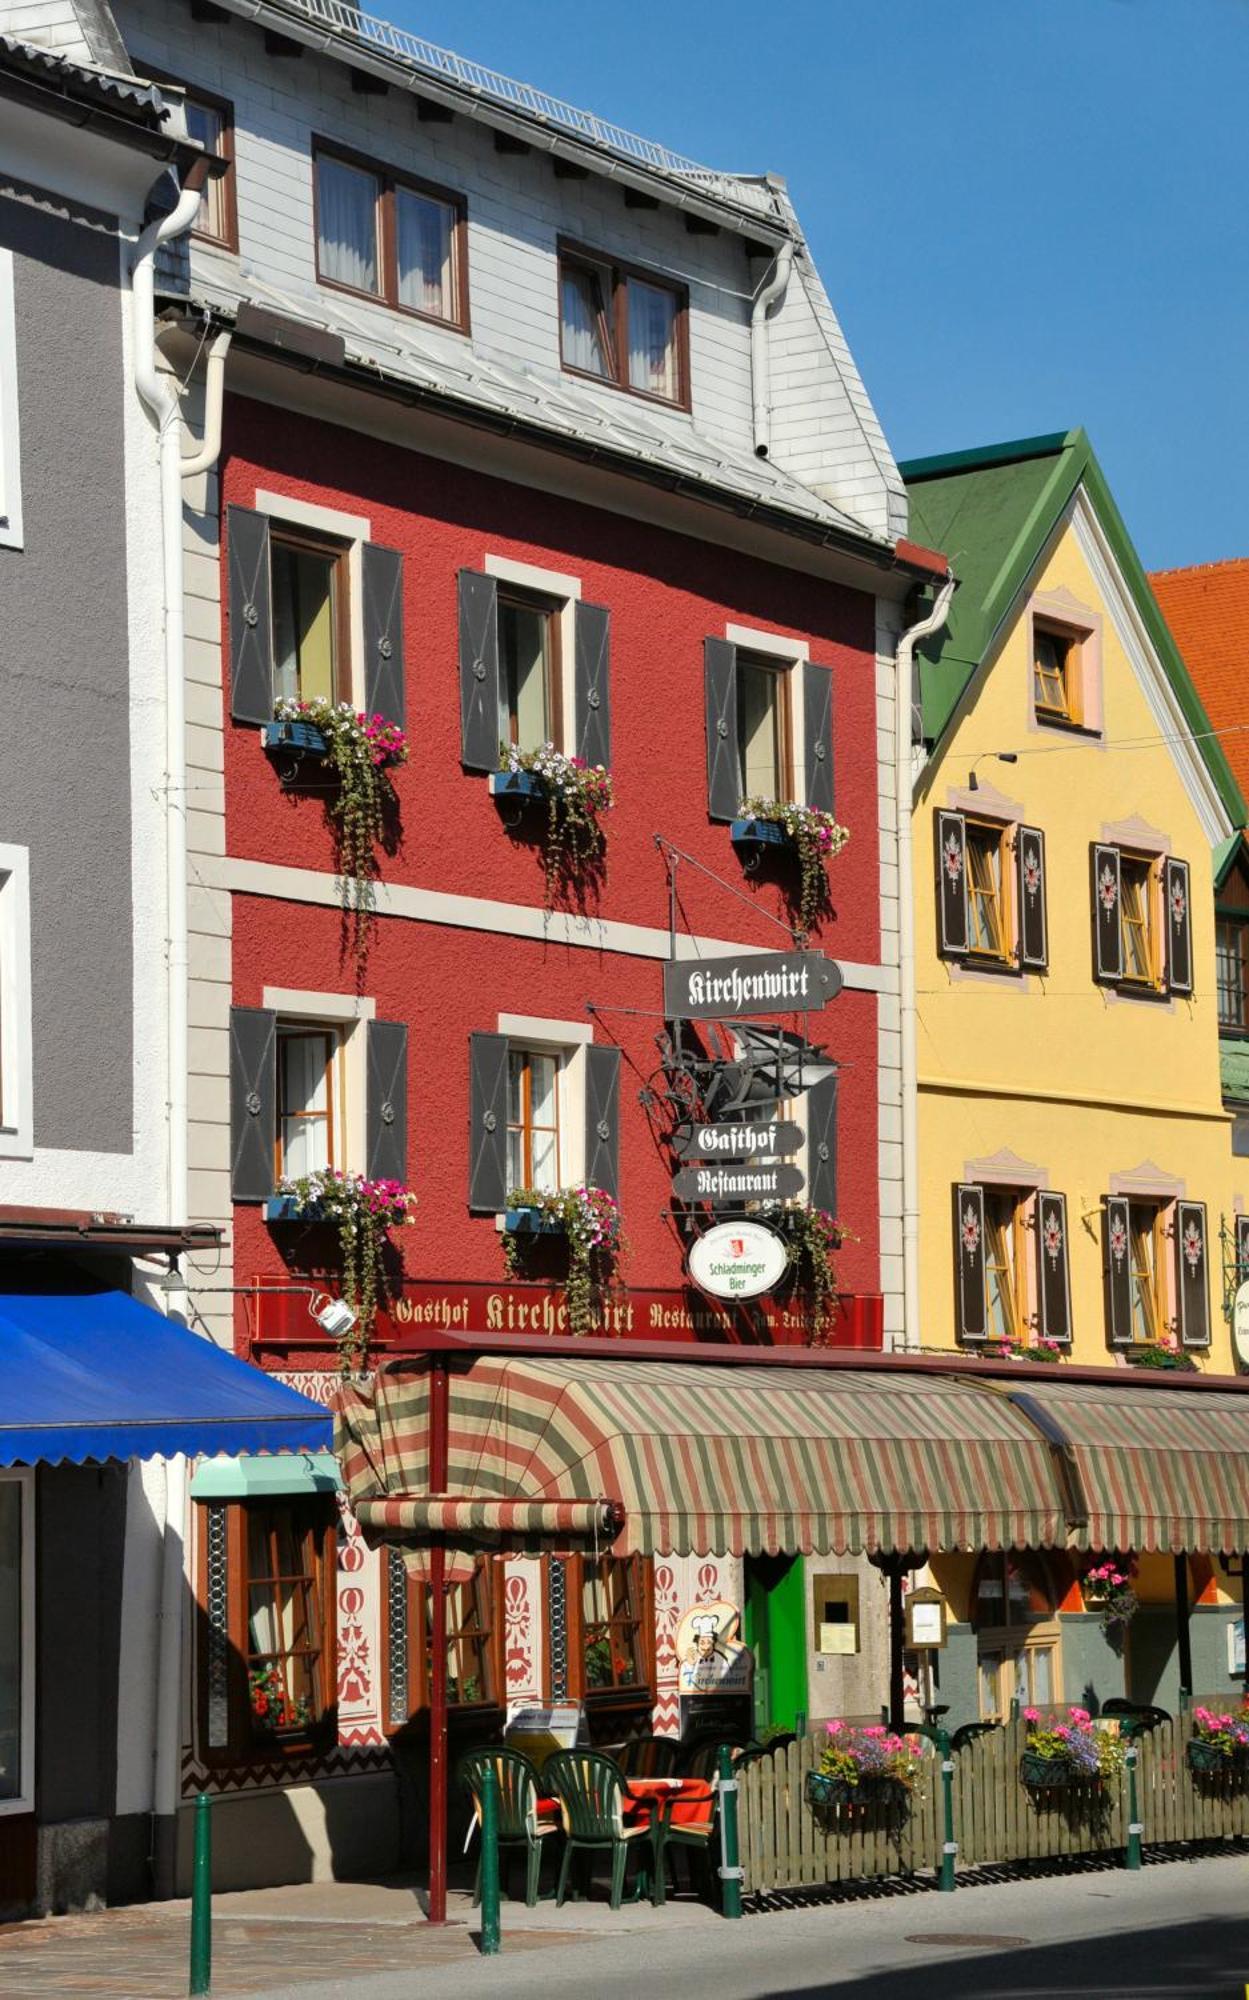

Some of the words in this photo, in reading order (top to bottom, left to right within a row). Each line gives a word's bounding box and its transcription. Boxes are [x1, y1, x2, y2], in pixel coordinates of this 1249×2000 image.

[688, 964, 809, 1012] Kirchenwirt
[698, 1125, 777, 1156] Gasthof
[696, 1169, 778, 1198] Restaurant
[709, 1262, 767, 1278] Schladminger
[729, 1276, 747, 1290] Bier
[395, 1297, 470, 1331] Gasthof
[486, 1294, 634, 1336] Kircheirt
